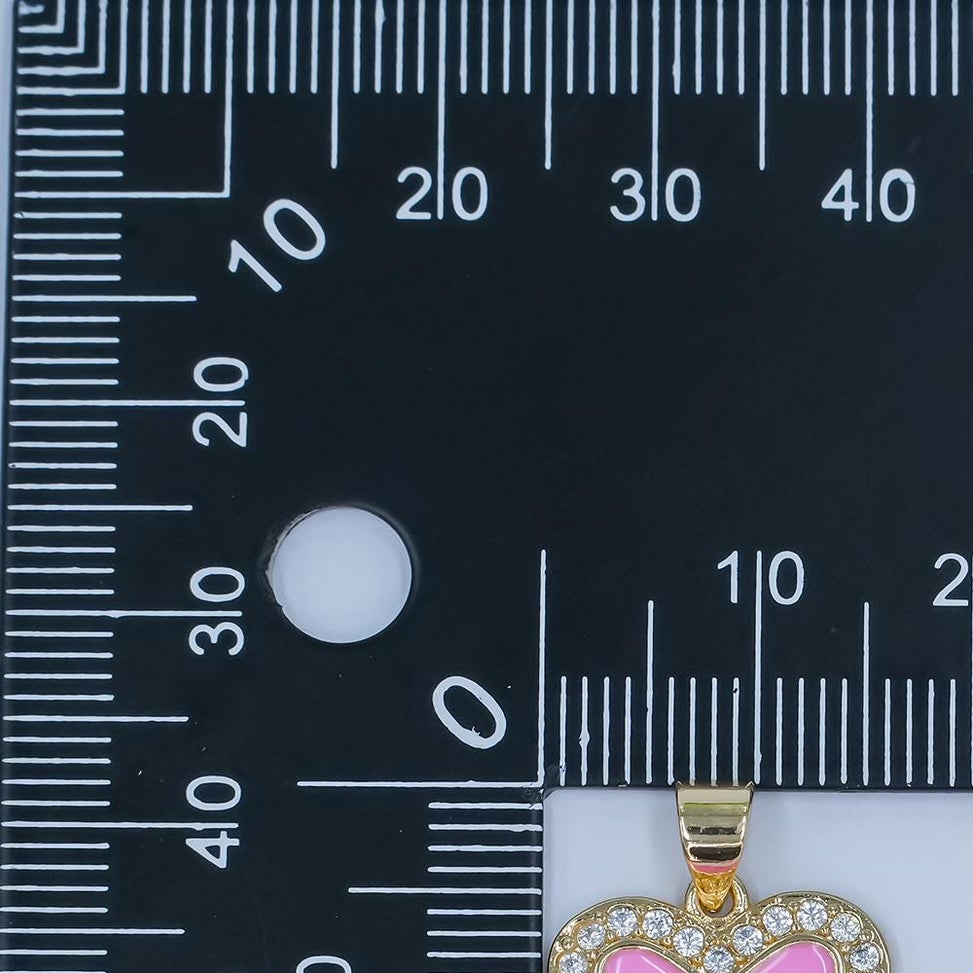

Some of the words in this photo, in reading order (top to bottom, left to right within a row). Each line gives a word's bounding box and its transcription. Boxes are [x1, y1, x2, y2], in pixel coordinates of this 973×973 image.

[396, 167, 487, 220] 20
[610, 168, 701, 221] 30
[822, 169, 915, 222] 40
[229, 199, 325, 292] 10
[192, 357, 248, 447] 20
[189, 567, 245, 655] 30
[718, 551, 805, 605] 10
[432, 676, 508, 749] 0
[186, 776, 241, 868] 40
